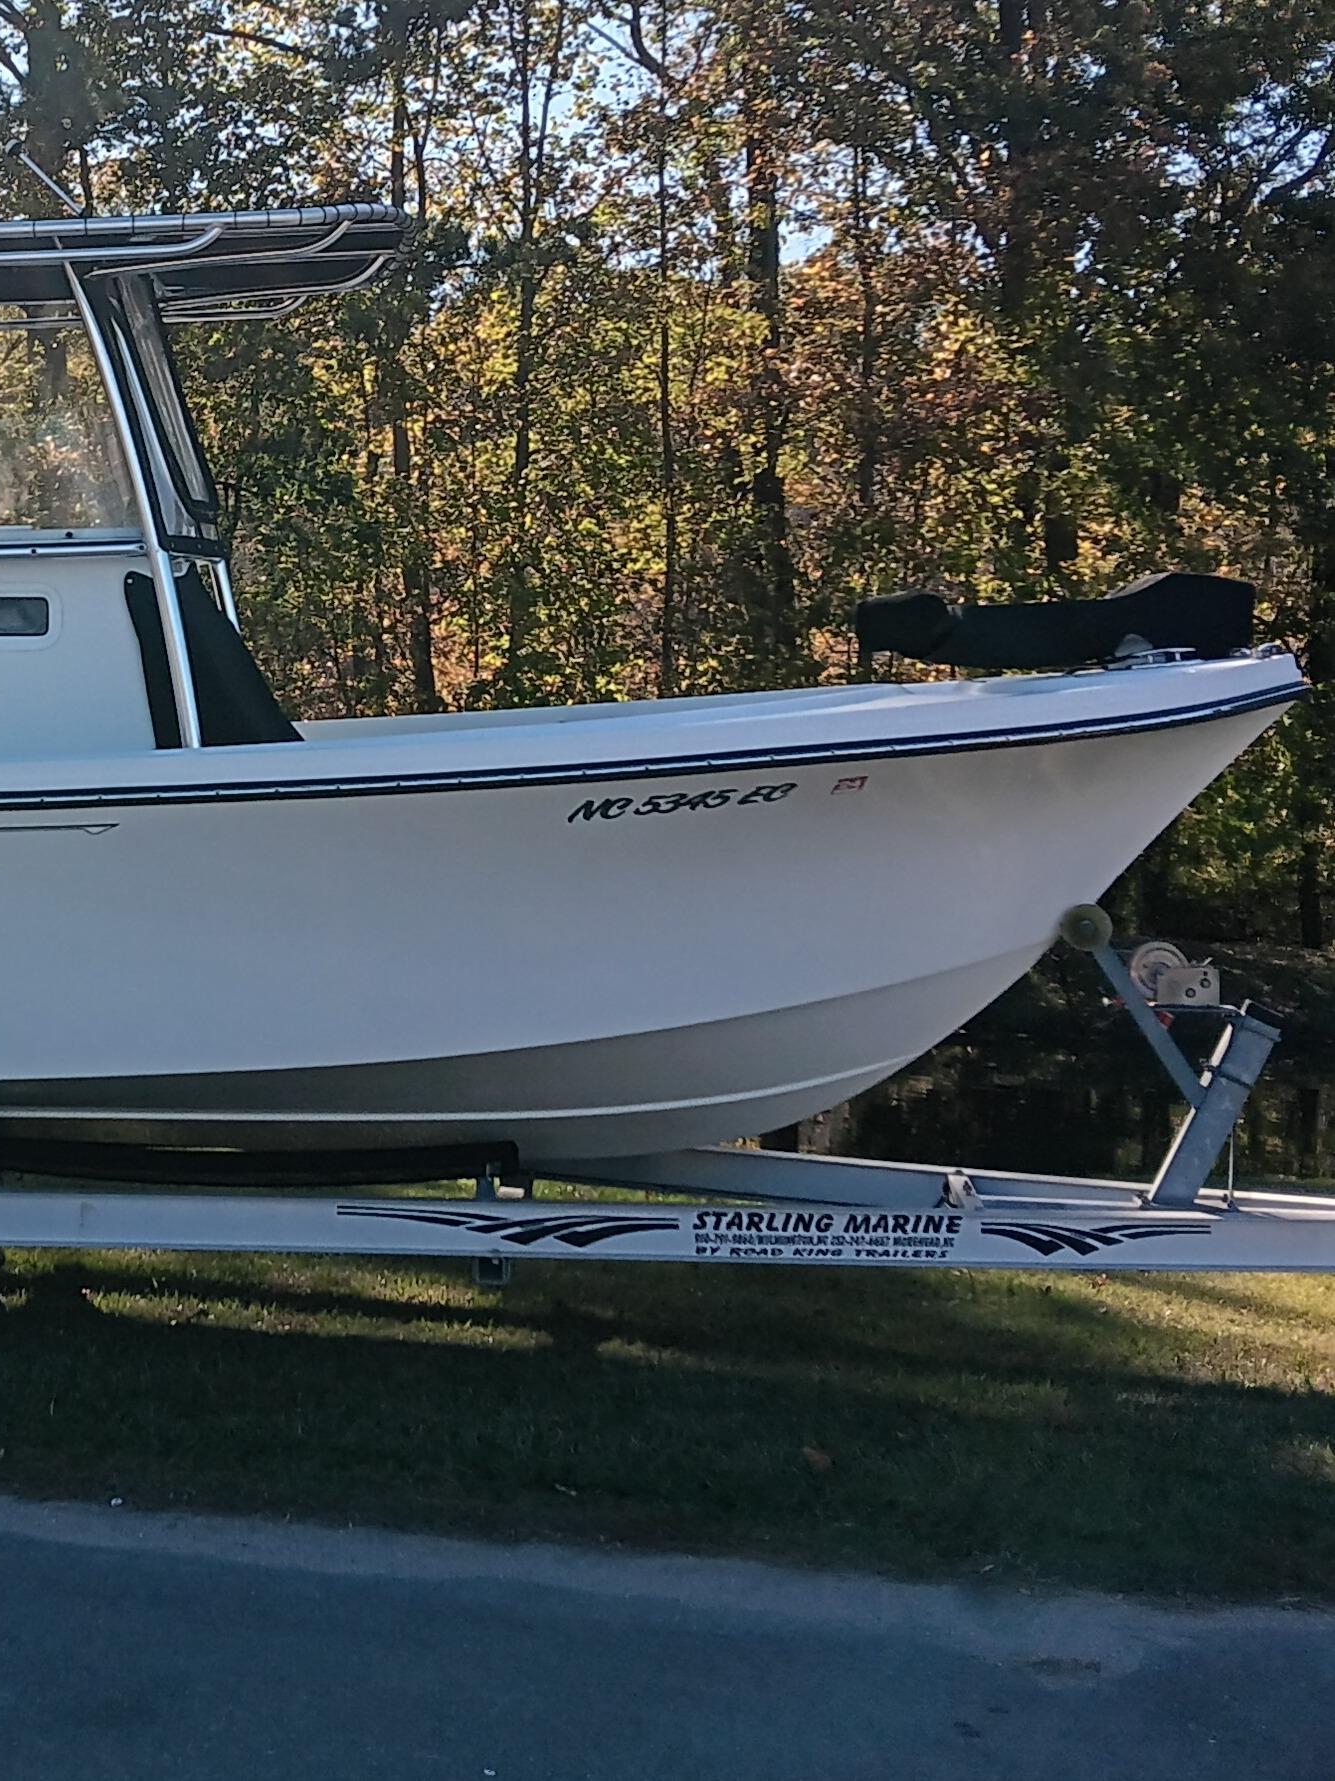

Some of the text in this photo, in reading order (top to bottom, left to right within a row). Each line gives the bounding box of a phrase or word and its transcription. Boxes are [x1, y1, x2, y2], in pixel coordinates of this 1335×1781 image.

[567, 797, 634, 823] NC
[692, 1210, 964, 1235] STARLING MARINE
[695, 1245, 721, 1256] BY
[854, 1248, 950, 1259] TRAILERS
